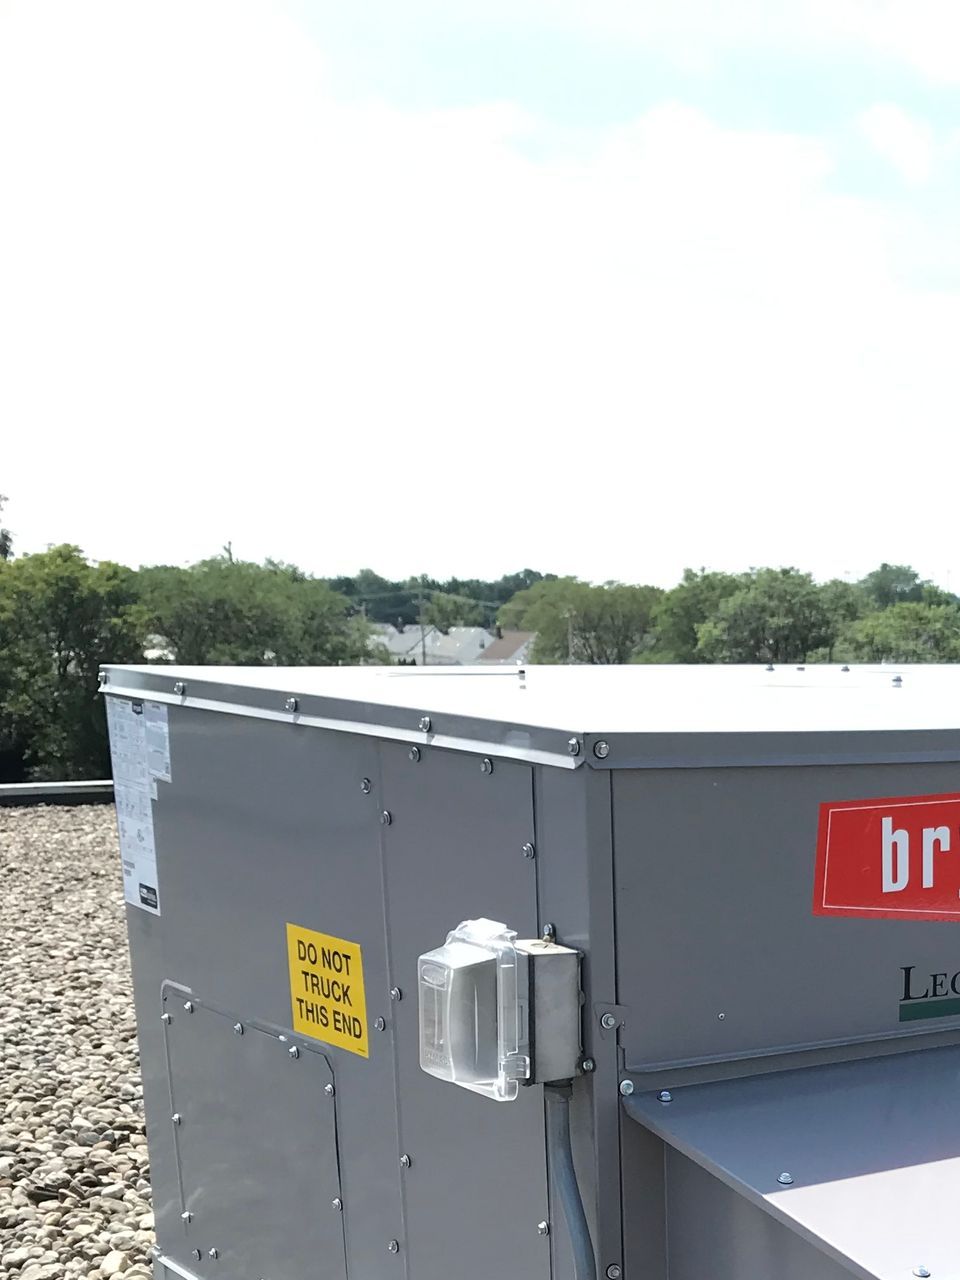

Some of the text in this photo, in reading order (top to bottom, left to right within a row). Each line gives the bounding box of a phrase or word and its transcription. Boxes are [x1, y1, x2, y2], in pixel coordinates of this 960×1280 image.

[297, 939, 351, 976] DO NOT
[301, 970, 352, 1007] TRUCK
[296, 997, 362, 1039] THIS END
